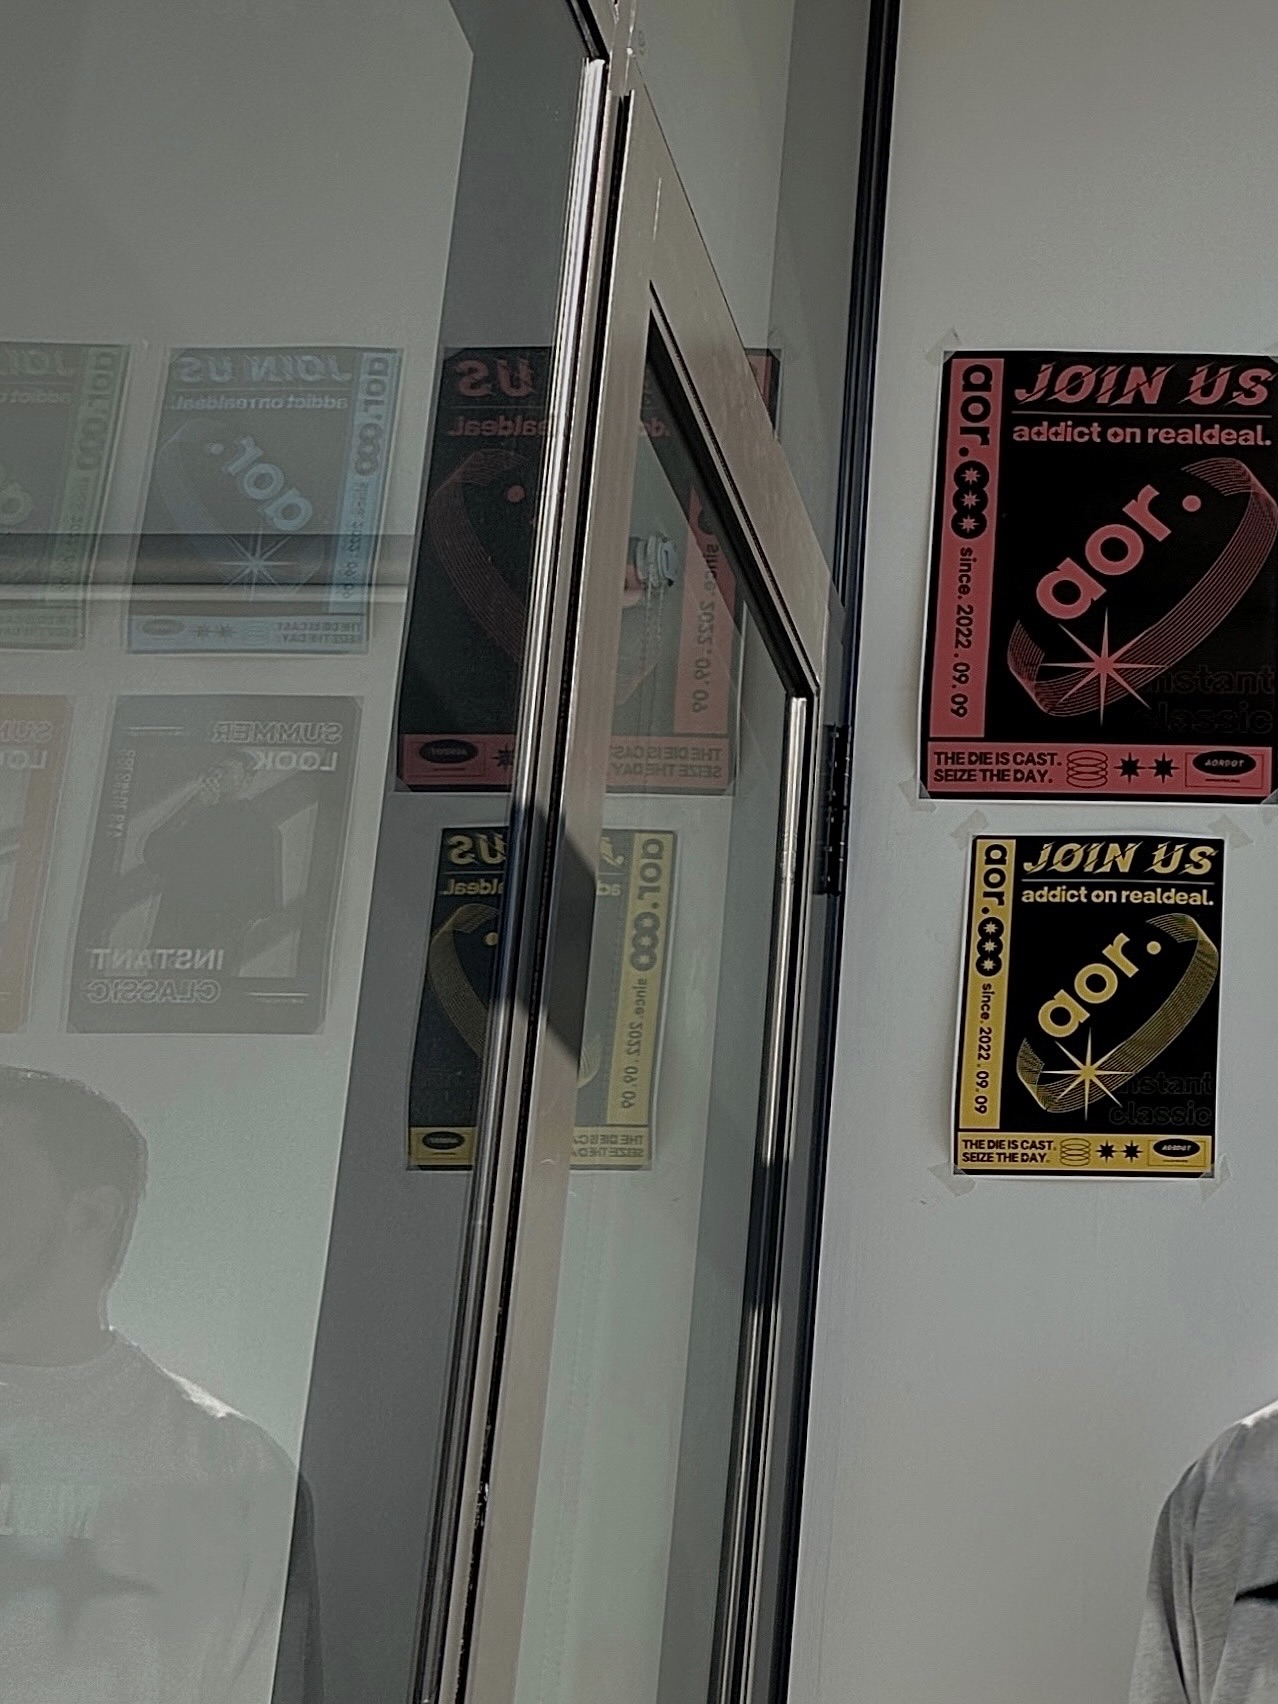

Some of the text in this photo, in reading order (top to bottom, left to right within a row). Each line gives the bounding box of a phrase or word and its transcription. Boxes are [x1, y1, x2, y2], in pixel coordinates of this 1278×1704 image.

[1014, 362, 1278, 406] JOIN US
[959, 364, 993, 457] aor.
[1013, 421, 1271, 445] addict on realdeal.
[934, 752, 1062, 766] THE DIE IS CAST.
[934, 769, 1053, 783] SEIZE THE DAY.
[1023, 841, 1218, 875] JOIN US
[981, 844, 1008, 915] aor.
[1022, 886, 1214, 906] addict on realdeal.
[962, 1139, 1057, 1151] THE DIE IS CAST.
[962, 1152, 1050, 1163] SEIZE THE DAY.
